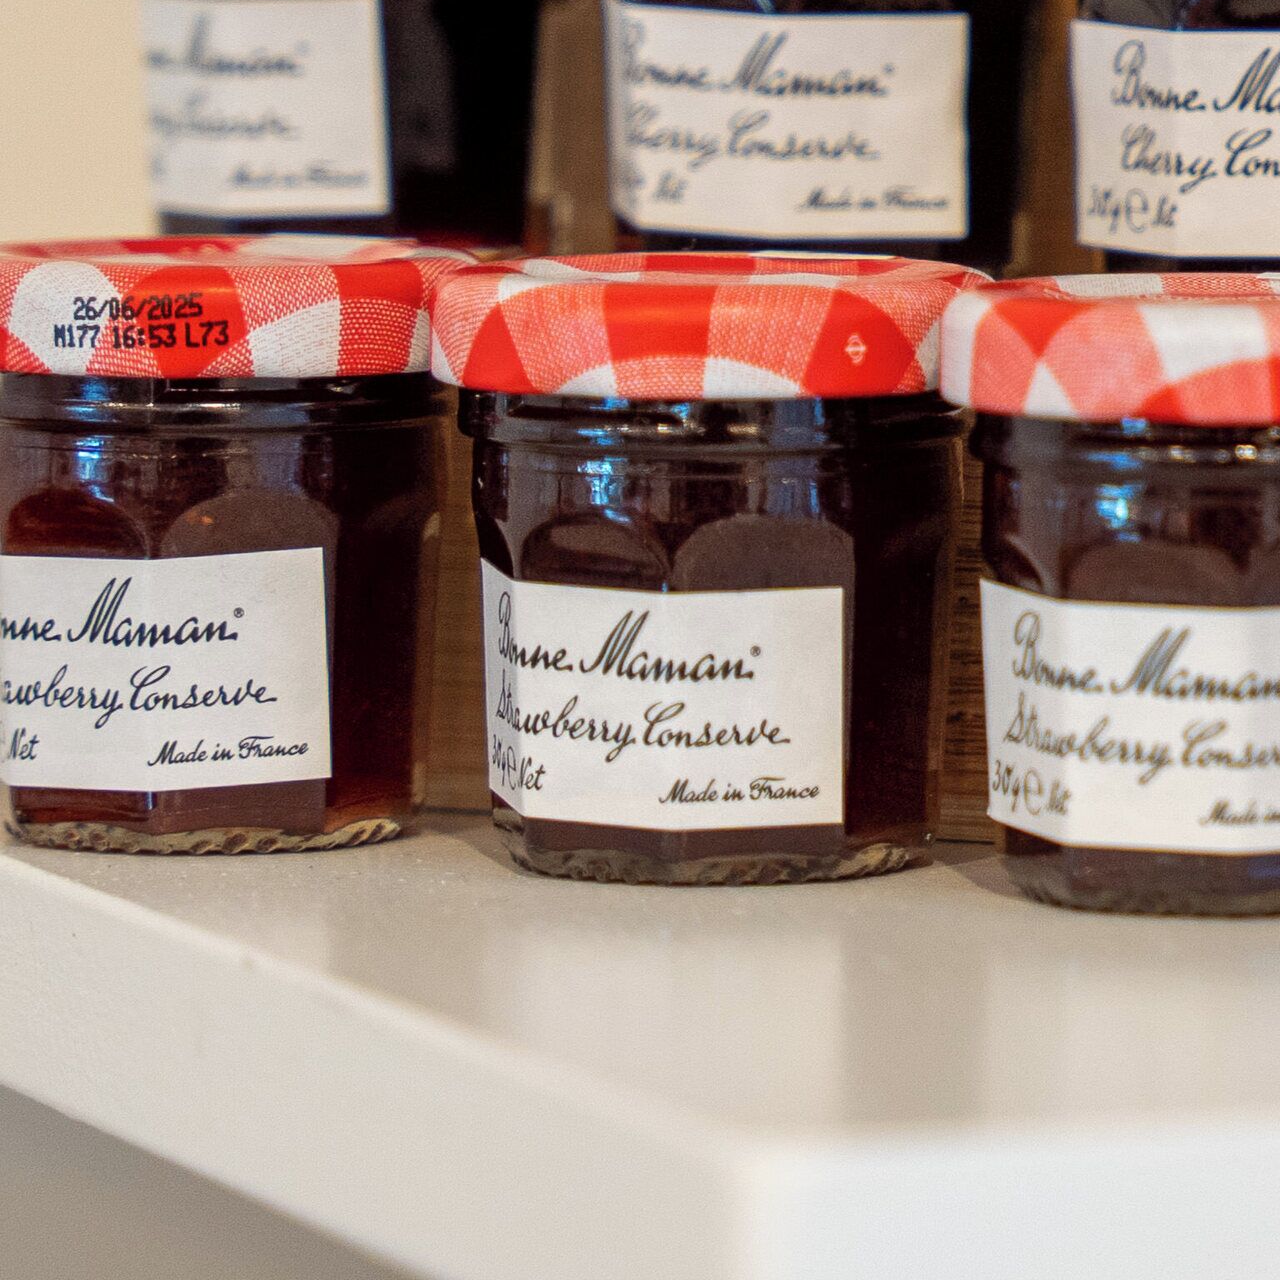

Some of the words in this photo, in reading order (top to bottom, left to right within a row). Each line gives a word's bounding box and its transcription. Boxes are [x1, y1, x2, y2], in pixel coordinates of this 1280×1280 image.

[73, 292, 204, 321] 26/06/2025
[111, 322, 177, 350] 16:53
[184, 319, 230, 348] L73
[0, 616, 62, 642] nne
[498, 591, 574, 672] Bonne
[2, 663, 124, 730] awberry
[128, 665, 278, 712] Conserve
[495, 668, 637, 764] Strawberry
[642, 700, 791, 749] Conserve
[8, 726, 40, 761] Net
[147, 738, 207, 767] Made
[210, 742, 235, 763] in
[237, 735, 310, 761] France
[657, 778, 719, 805] Made
[722, 784, 746, 802] in
[748, 776, 820, 802] France
